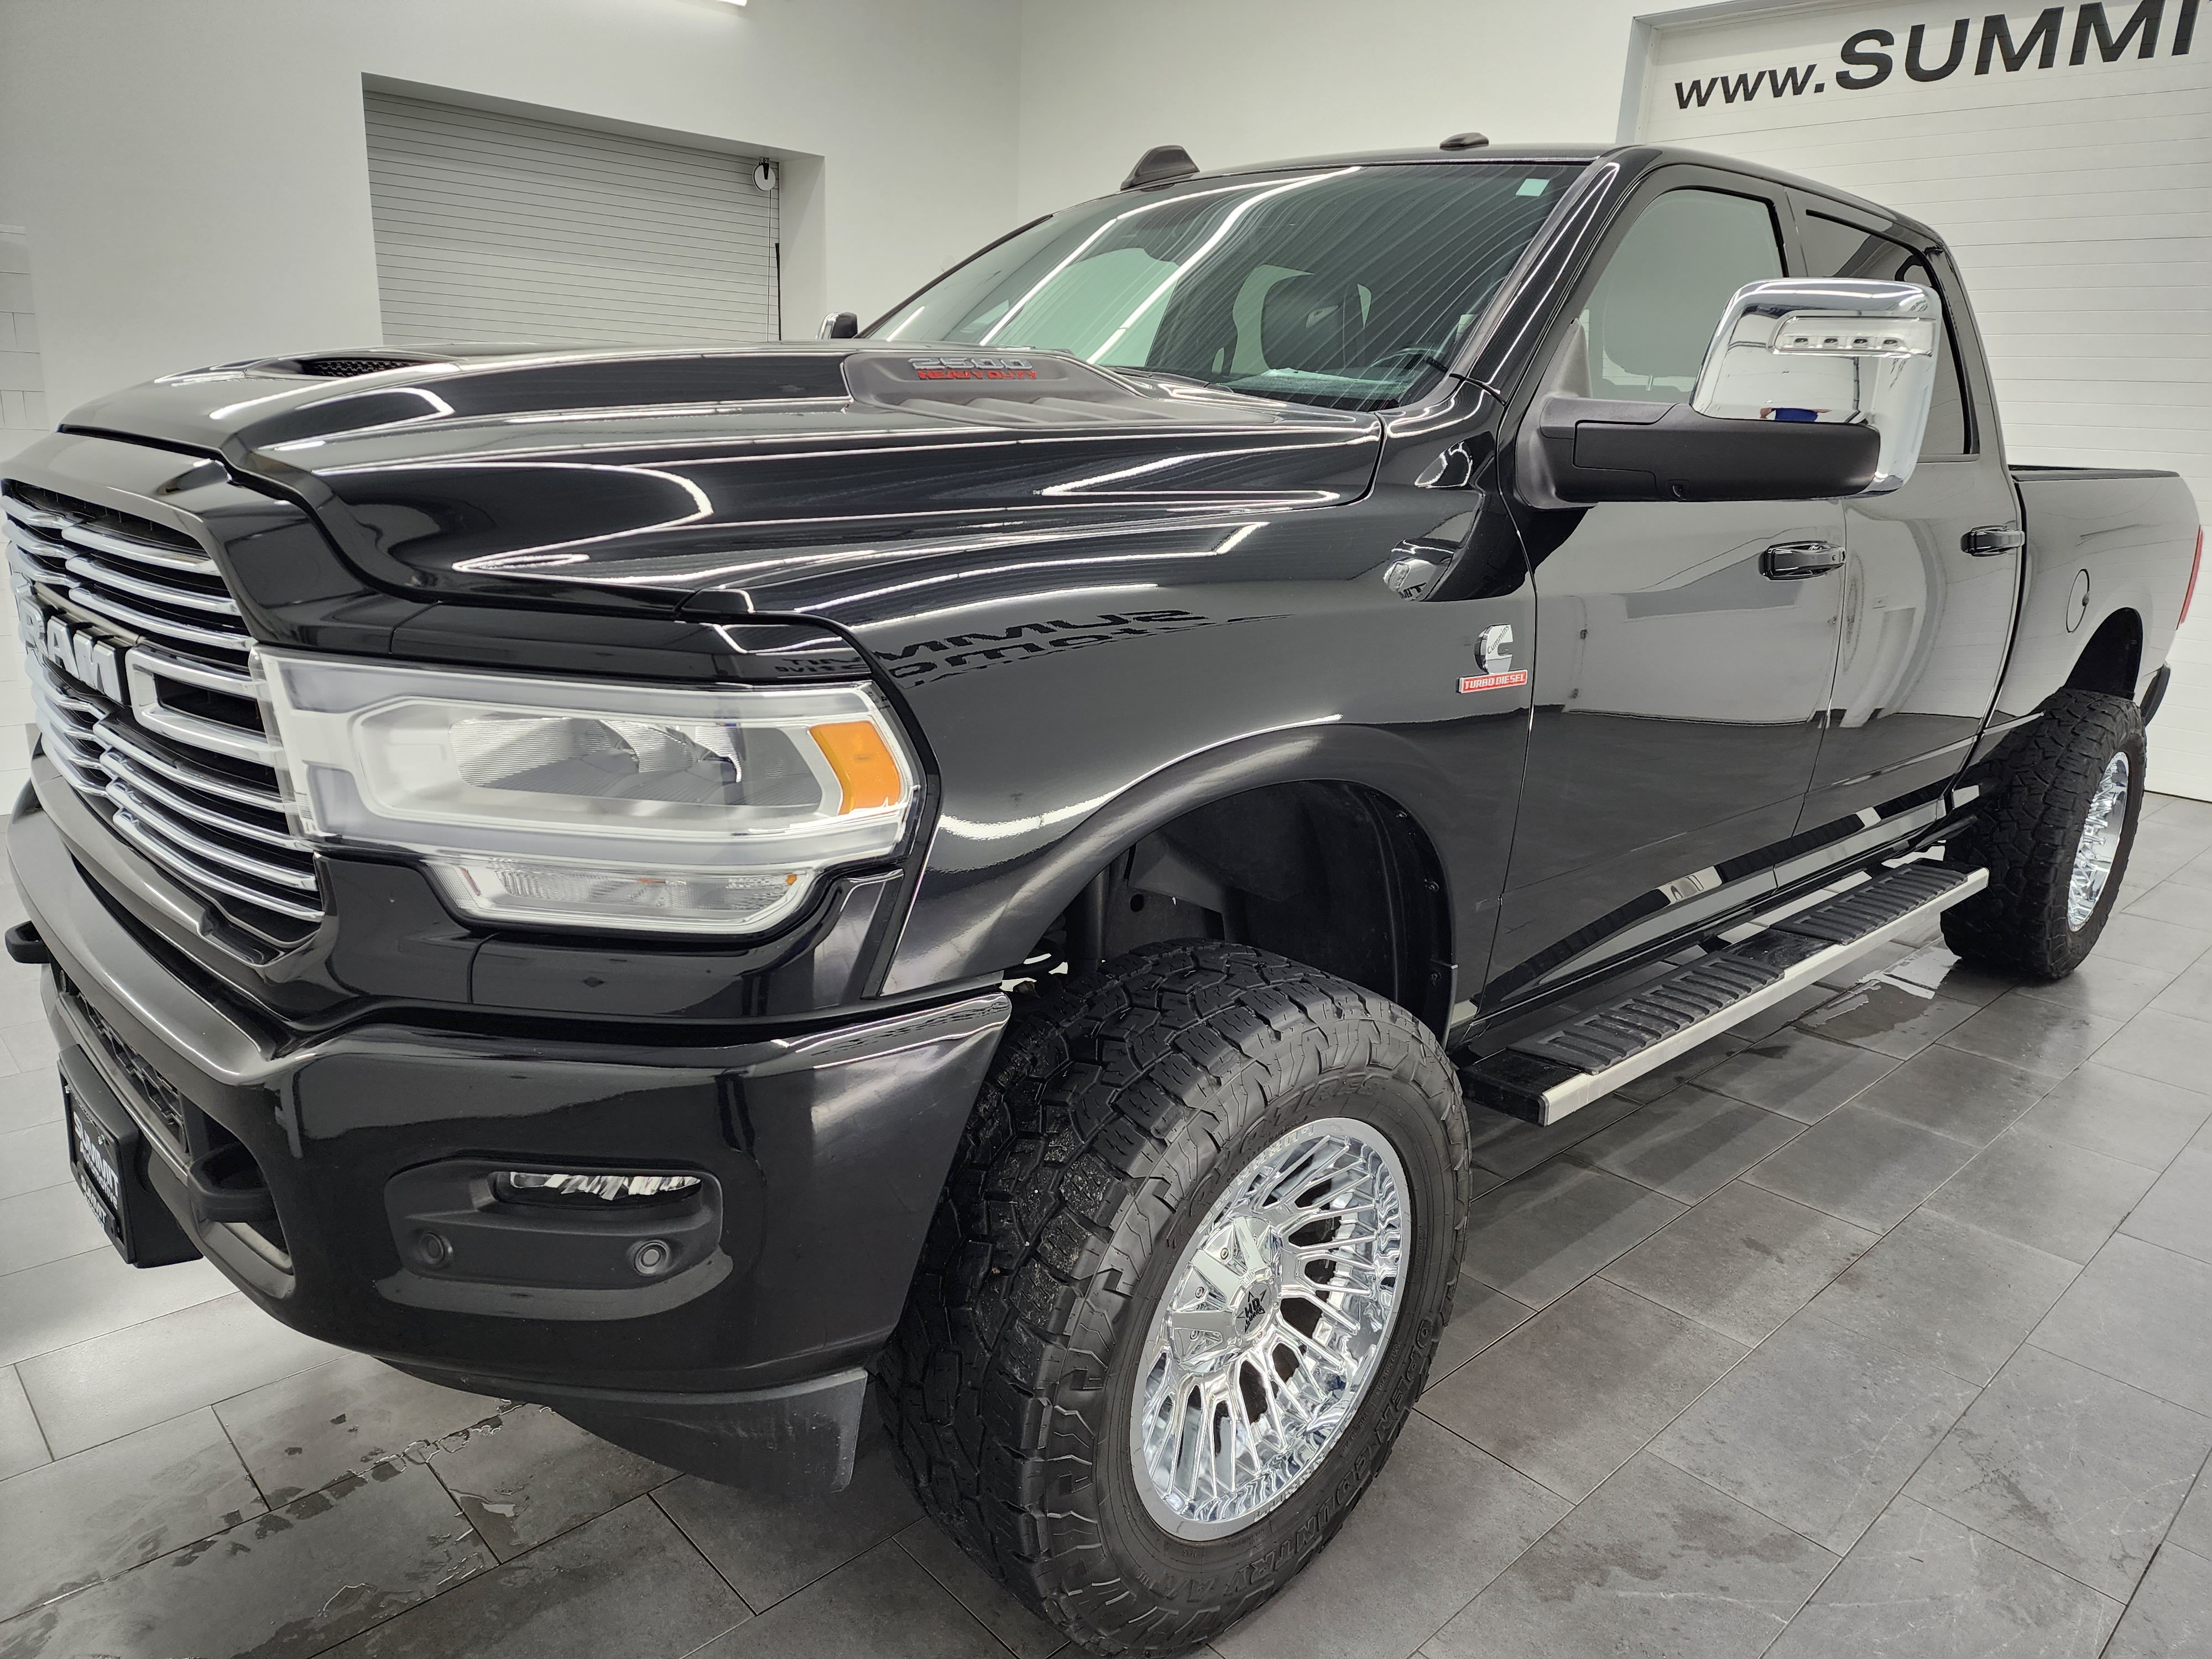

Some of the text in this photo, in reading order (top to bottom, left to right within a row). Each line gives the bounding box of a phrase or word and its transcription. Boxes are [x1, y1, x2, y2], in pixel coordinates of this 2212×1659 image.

[907, 357, 1033, 370] 2500
[917, 370, 1037, 380] HEAVY DUTY
[20, 596, 122, 703] RAM
[1487, 625, 1509, 655] Cummins
[1464, 673, 1525, 690] TURBO DIESEL
[1272, 1072, 1390, 1127] TIRES
[74, 1111, 119, 1198] SUMMIT
[1244, 1297, 1261, 1318] HD
[1375, 1316, 1434, 1444] OPEN
[1222, 1444, 1373, 1596] COUNTRY
